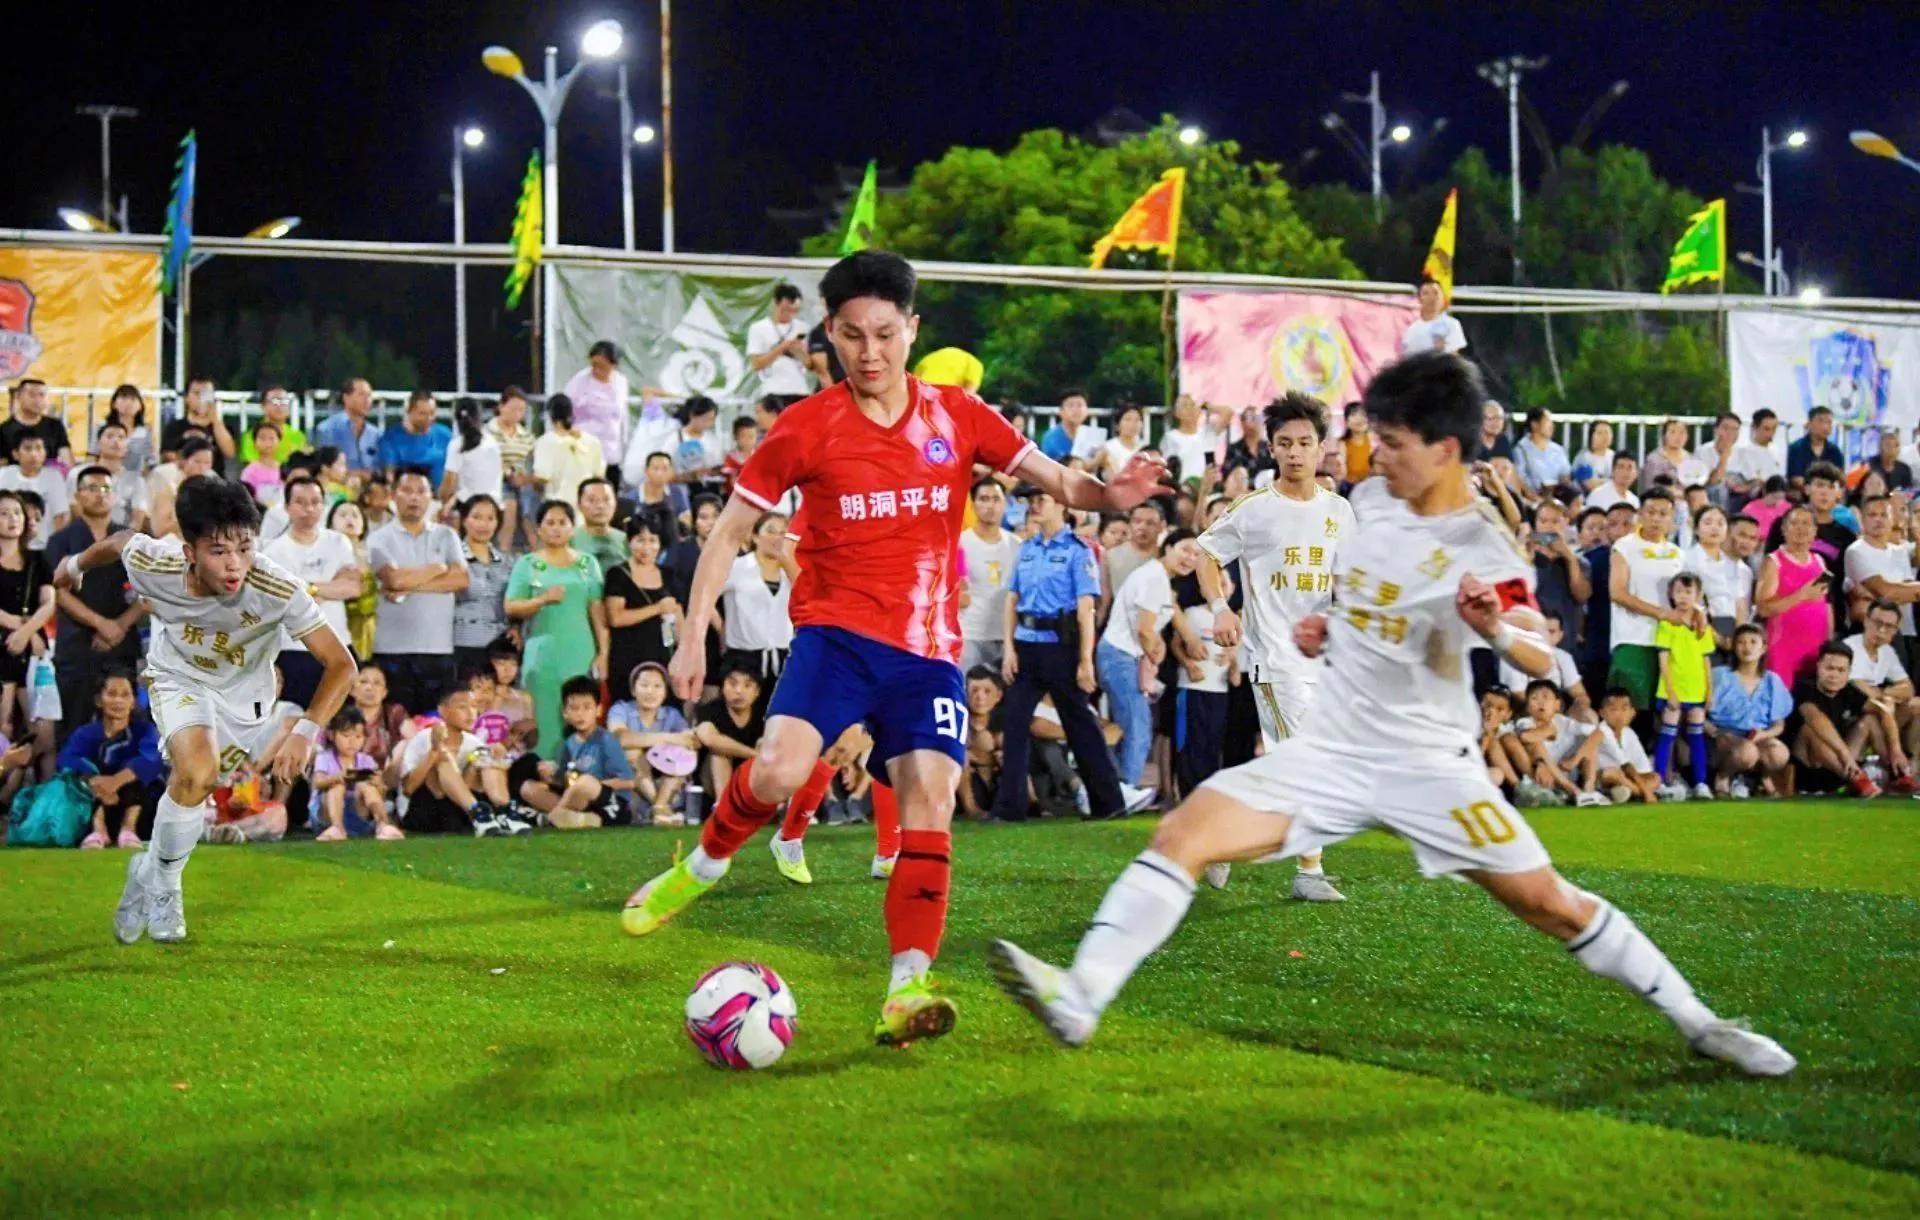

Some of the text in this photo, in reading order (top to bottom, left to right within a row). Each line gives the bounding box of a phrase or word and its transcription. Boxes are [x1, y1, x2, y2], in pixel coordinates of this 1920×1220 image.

[838, 484, 952, 520] 朗洞平地
[1283, 546, 1324, 566] 乐里
[933, 697, 968, 744] 97
[1449, 801, 1517, 848] 10
